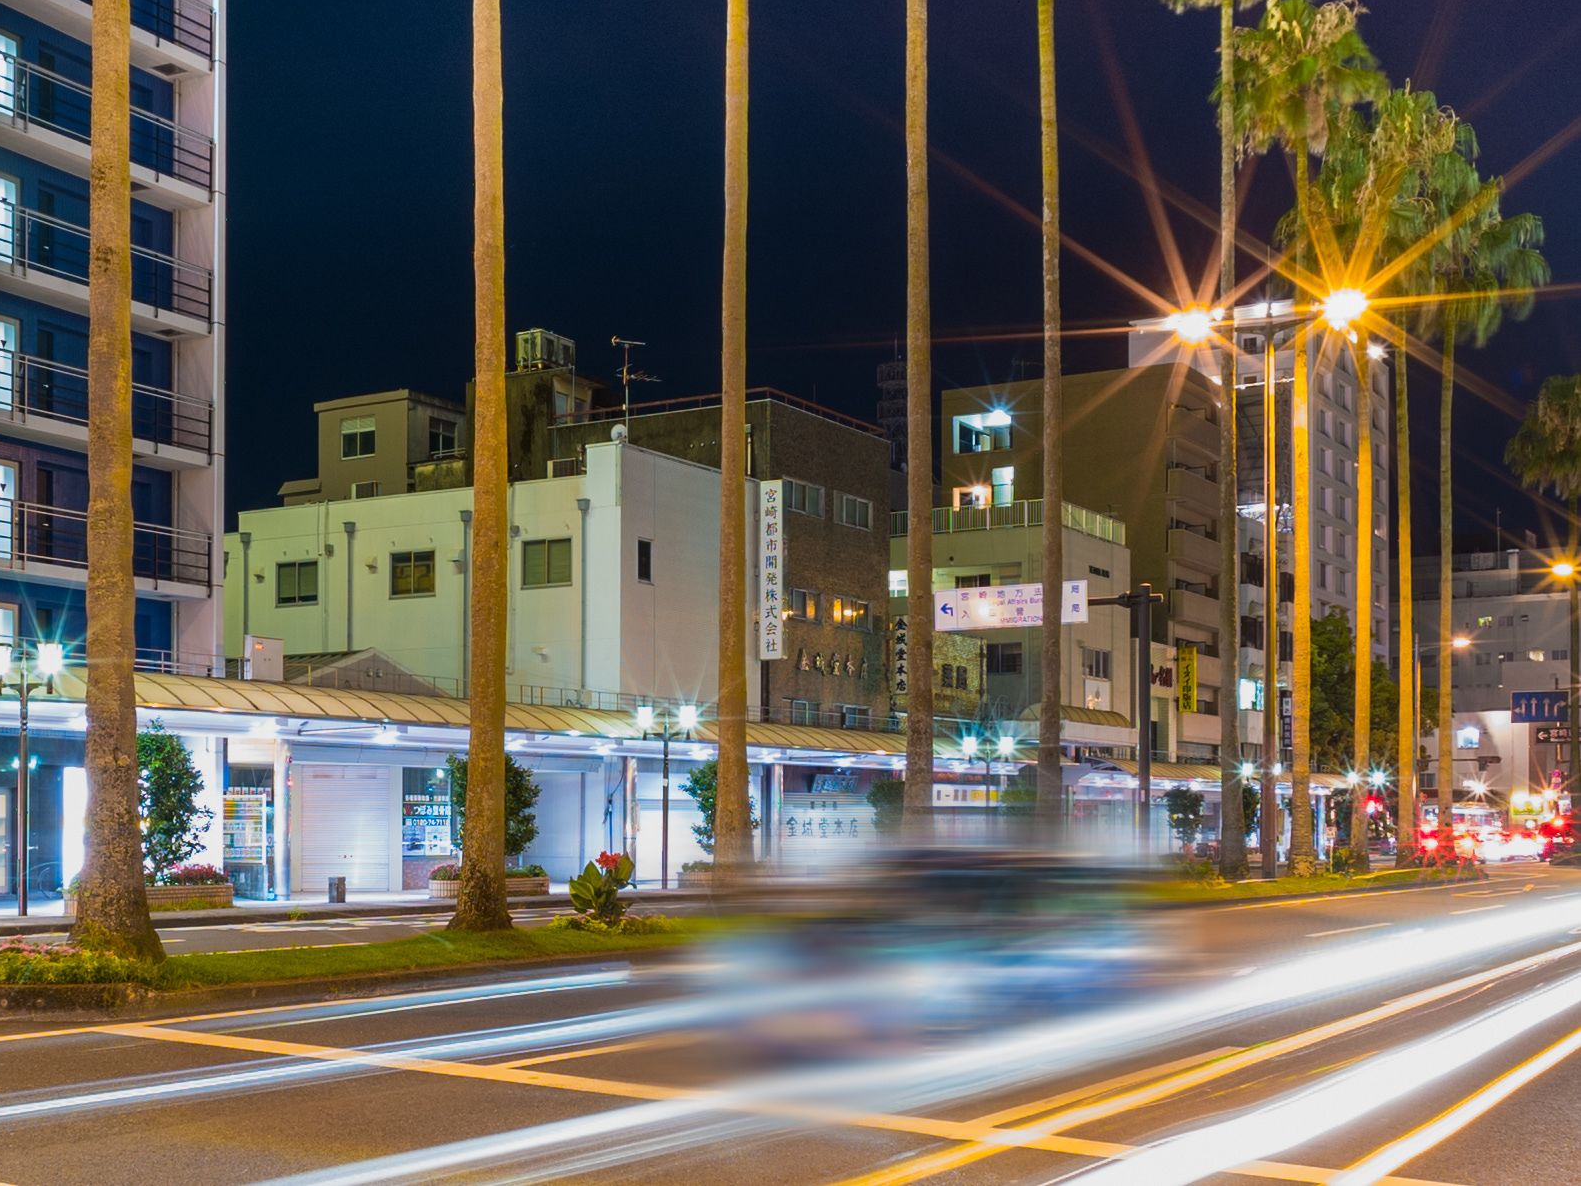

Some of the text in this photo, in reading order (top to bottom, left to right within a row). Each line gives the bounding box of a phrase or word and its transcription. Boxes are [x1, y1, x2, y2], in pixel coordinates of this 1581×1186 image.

[765, 488, 778, 653] 宮崎都市開発株式会社
[961, 584, 1080, 601] 宮崎地方法局
